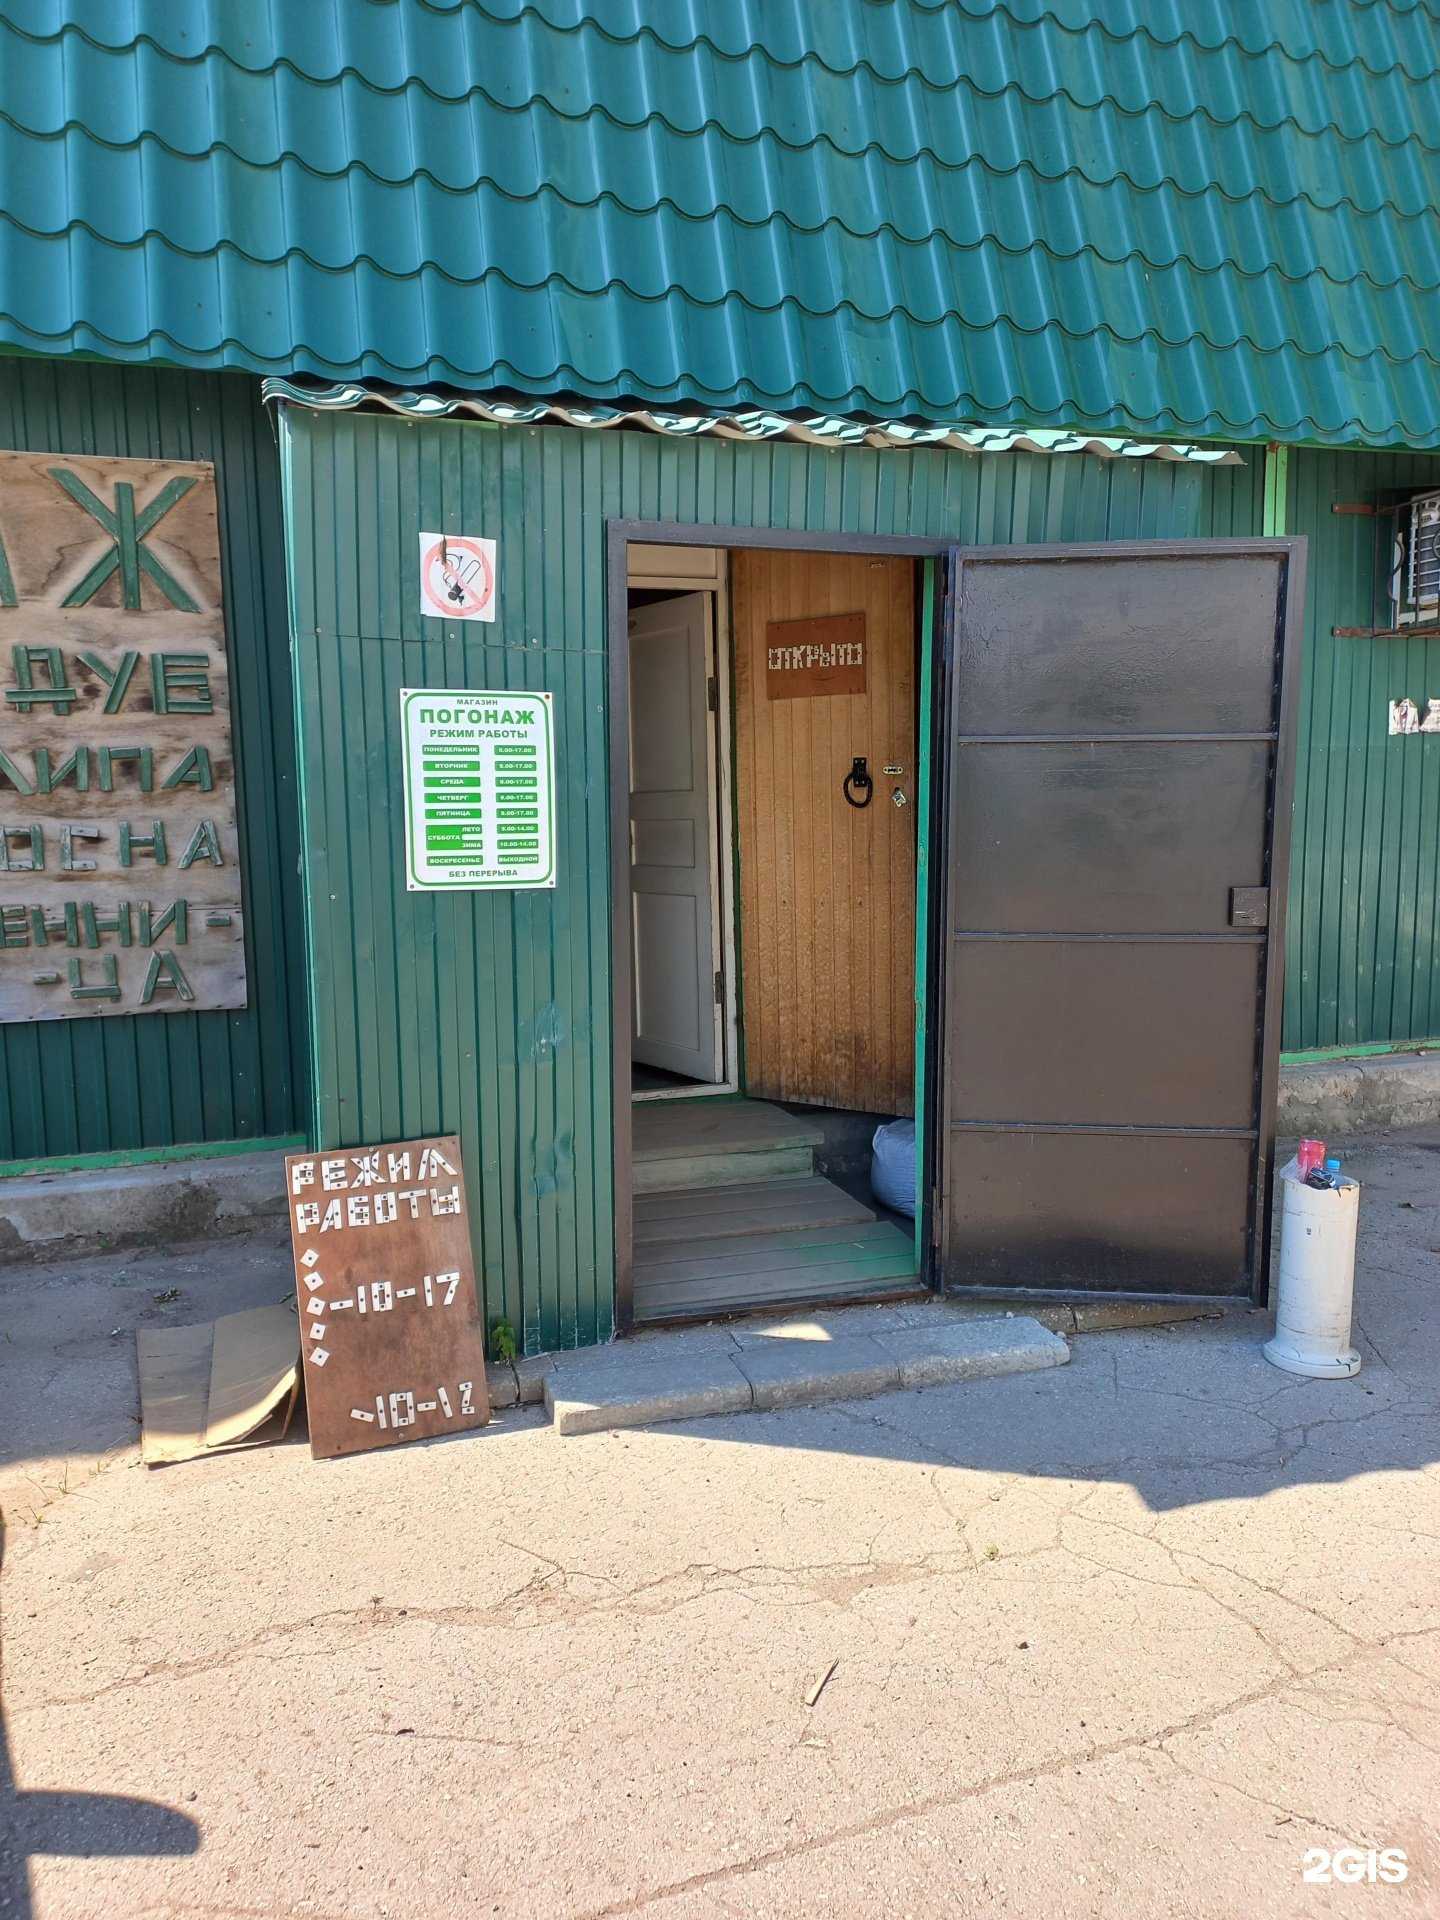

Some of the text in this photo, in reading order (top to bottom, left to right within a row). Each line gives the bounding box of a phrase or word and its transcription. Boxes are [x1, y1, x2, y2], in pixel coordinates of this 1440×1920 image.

[769, 643, 862, 670] ОТКРЫТО
[456, 698, 498, 706] МАГАЗИН
[420, 708, 535, 725] ПОГОНАЖ
[429, 729, 528, 739] РЕЖИМ РАБОТЫ
[498, 855, 538, 863] ВЫХОДНОЙ
[469, 869, 518, 878] ПЕРЕРЫВА
[295, 1186, 461, 1234] РАБОТЫ
